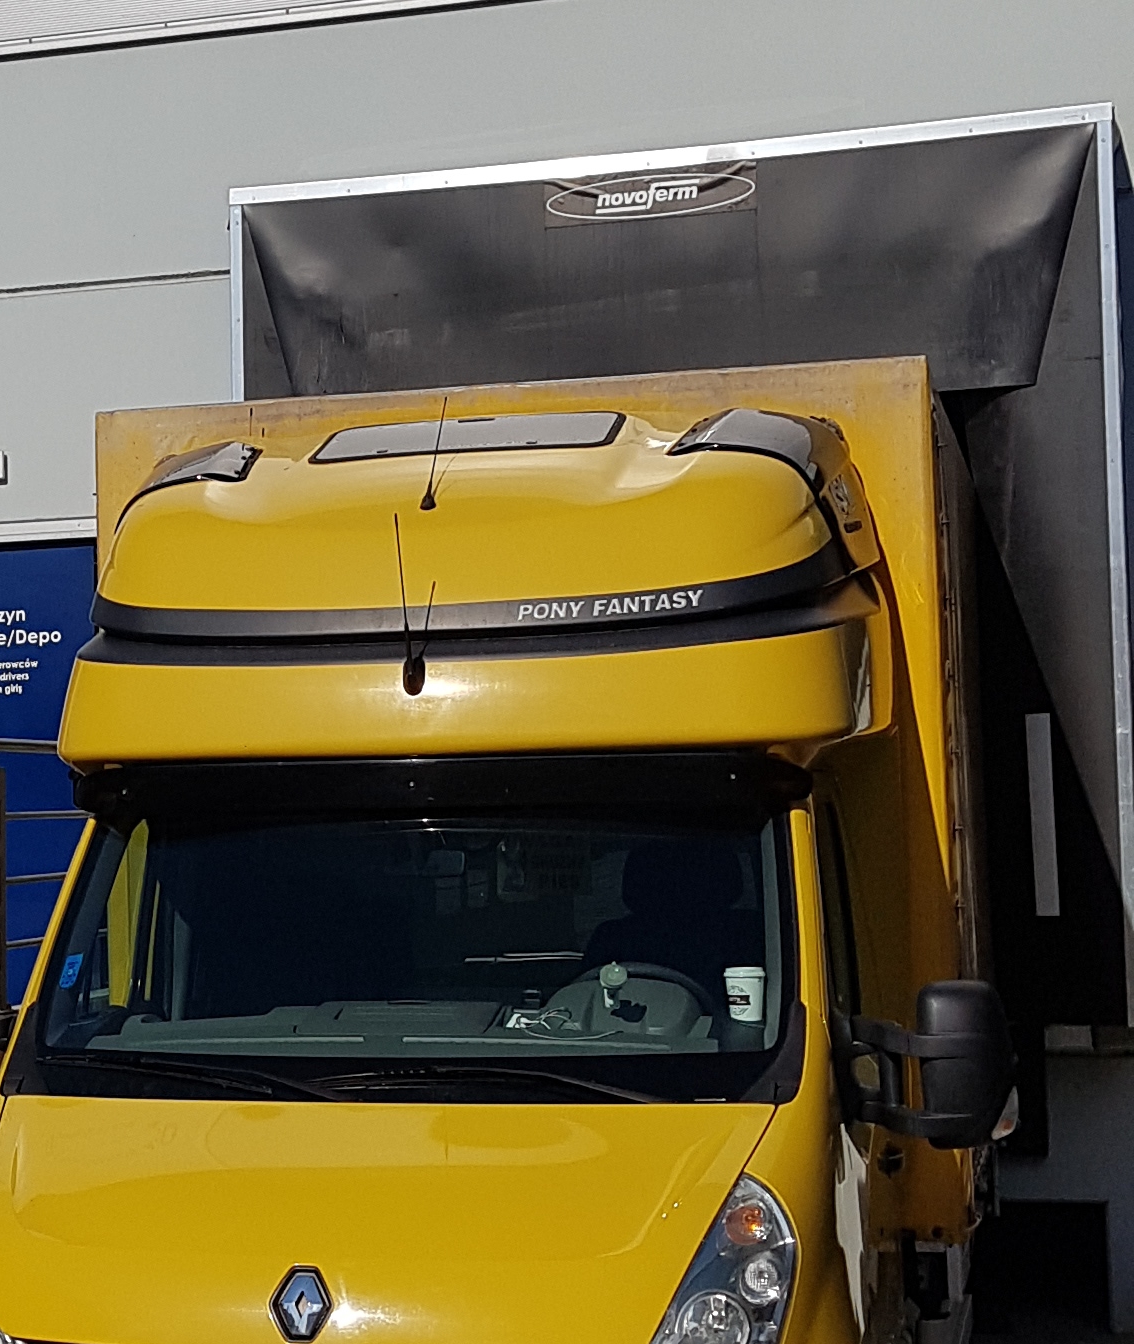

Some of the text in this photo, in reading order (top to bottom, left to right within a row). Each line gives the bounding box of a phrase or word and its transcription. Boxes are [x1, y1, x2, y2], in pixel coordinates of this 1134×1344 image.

[596, 180, 699, 214] novoferm
[517, 589, 704, 621] PONY FANTASY
[0, 671, 30, 681] drivers
